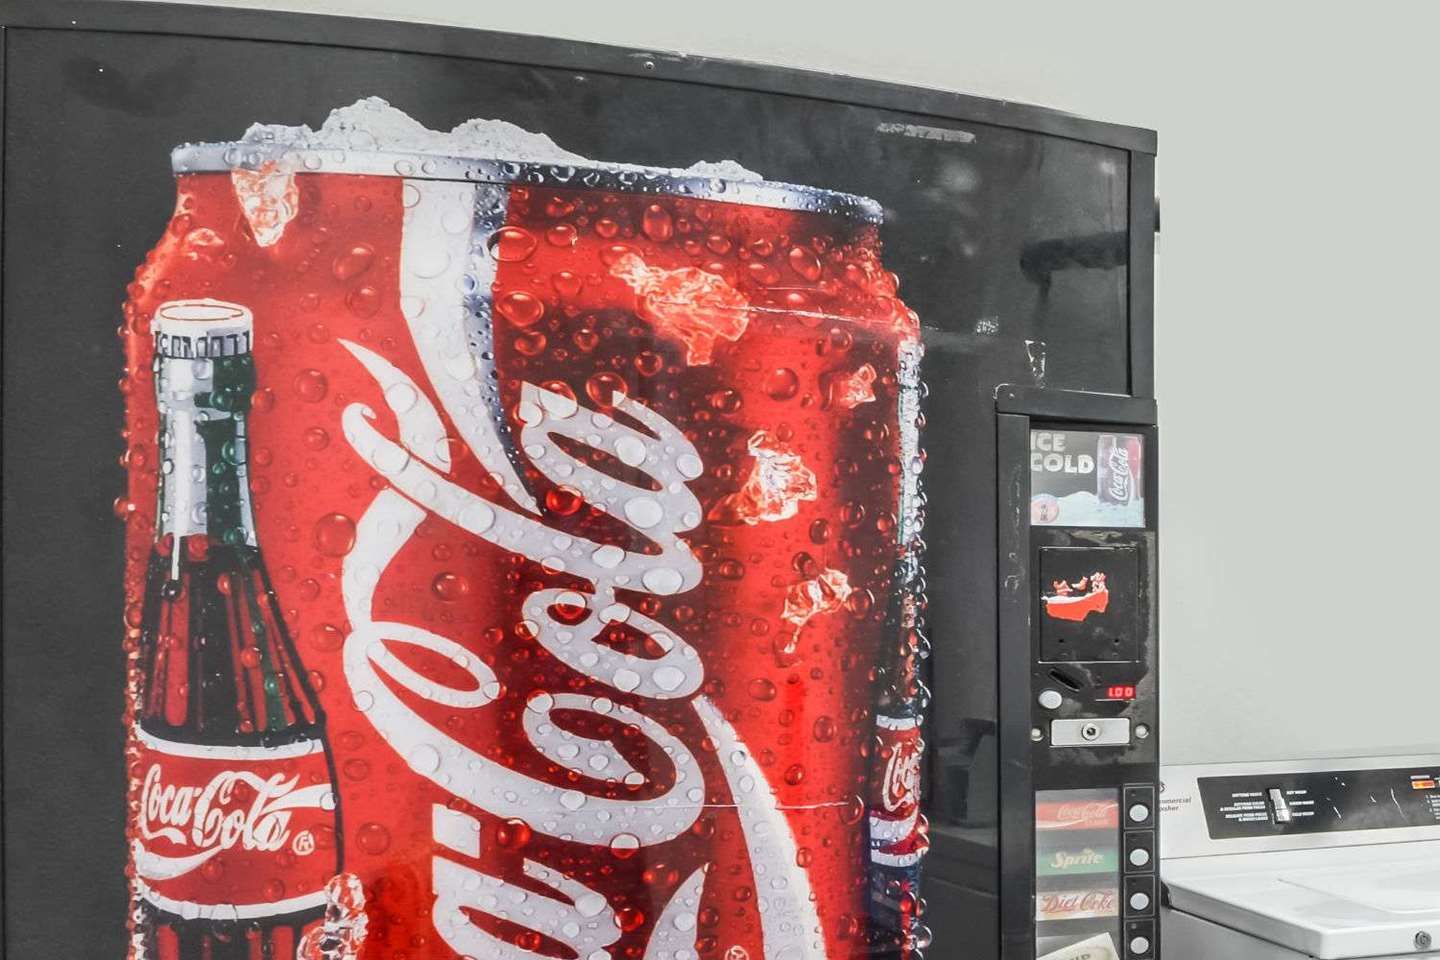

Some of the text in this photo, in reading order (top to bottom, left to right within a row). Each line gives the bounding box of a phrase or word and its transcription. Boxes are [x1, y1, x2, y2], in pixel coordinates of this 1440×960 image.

[1031, 431, 1066, 452] ICE
[1031, 453, 1096, 474] COLD
[1108, 447, 1129, 502] Coca-Cola
[140, 763, 301, 852] Coca-Cola
[1050, 848, 1105, 870] Sprite
[1041, 892, 1078, 913] Diet
